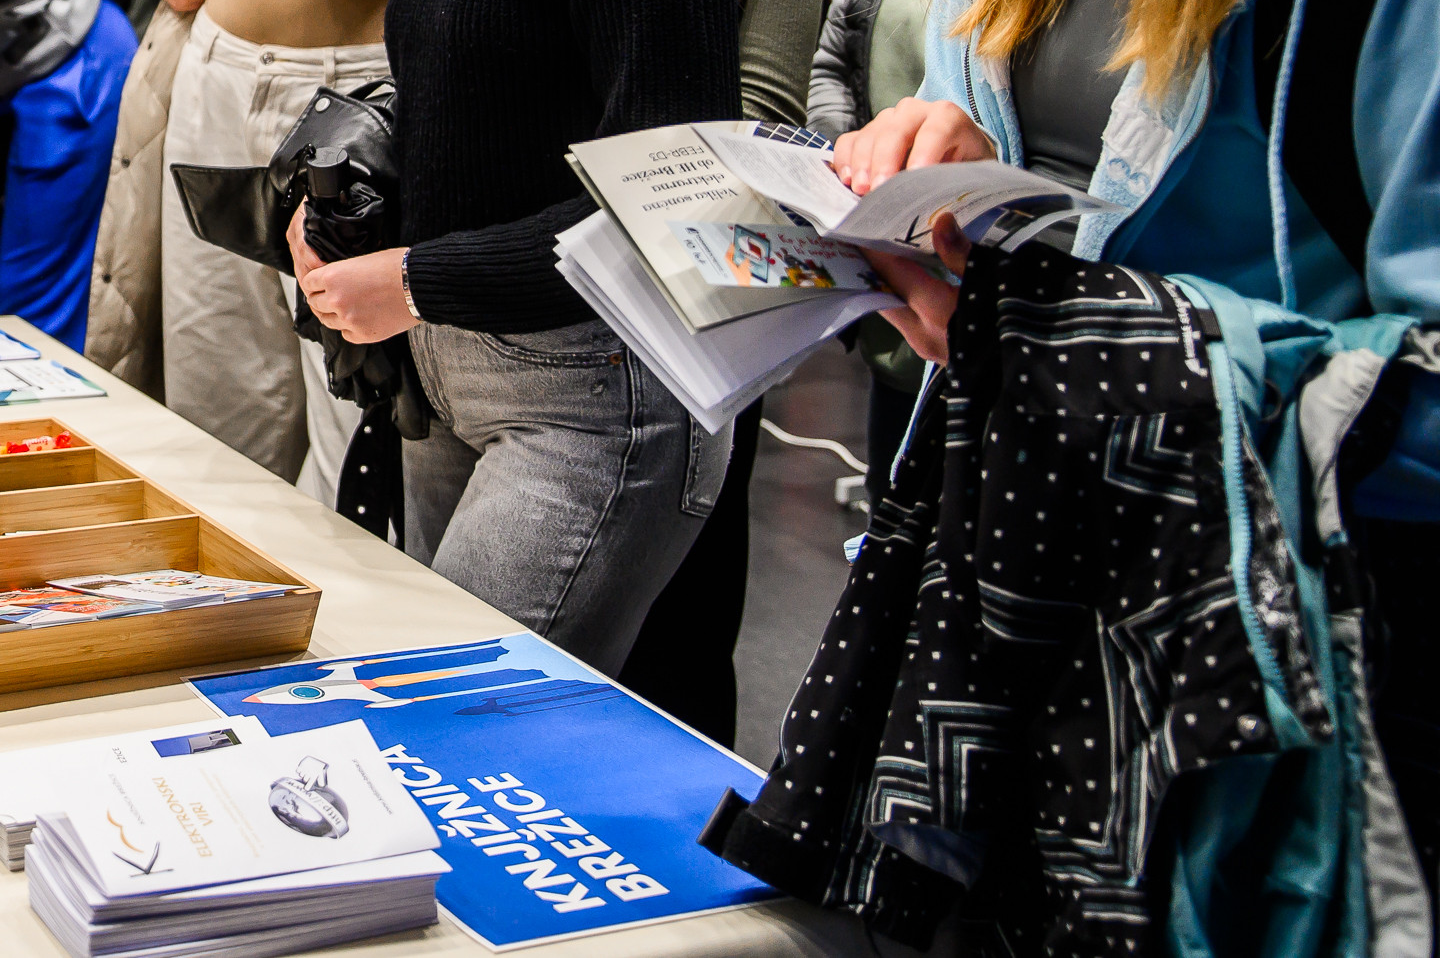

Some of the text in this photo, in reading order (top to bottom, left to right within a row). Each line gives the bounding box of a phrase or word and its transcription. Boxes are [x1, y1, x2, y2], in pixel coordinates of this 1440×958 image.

[648, 145, 705, 162] FEBR-D3
[620, 158, 714, 182] ob HE Brežice
[651, 172, 725, 193] elektrarna
[641, 187, 739, 212] Velika sončna
[151, 776, 214, 858] ELEKTRONSKI
[189, 801, 214, 827] VIRI
[379, 744, 607, 913] KNJIŽNICA
[466, 772, 671, 902] BREŽICE
